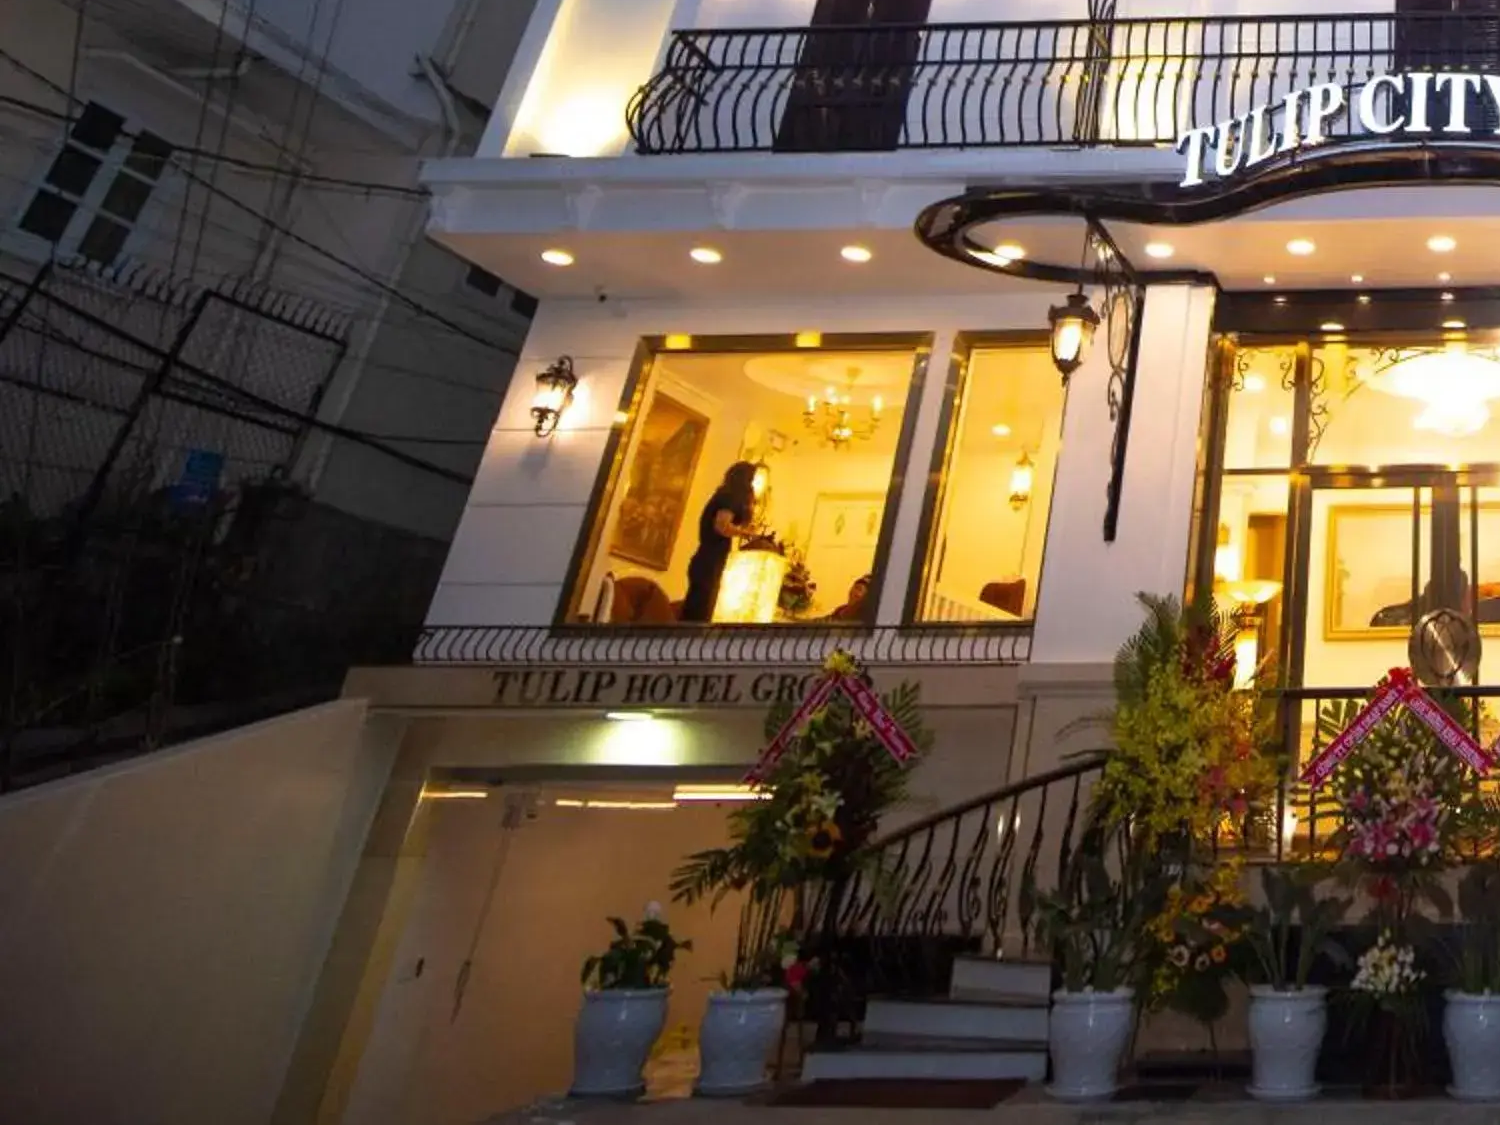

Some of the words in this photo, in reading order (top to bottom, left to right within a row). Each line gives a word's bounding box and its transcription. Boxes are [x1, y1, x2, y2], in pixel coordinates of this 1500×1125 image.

[1175, 82, 1346, 187] TULIP
[492, 671, 616, 705] TULIP
[621, 672, 742, 704] HOTEL
